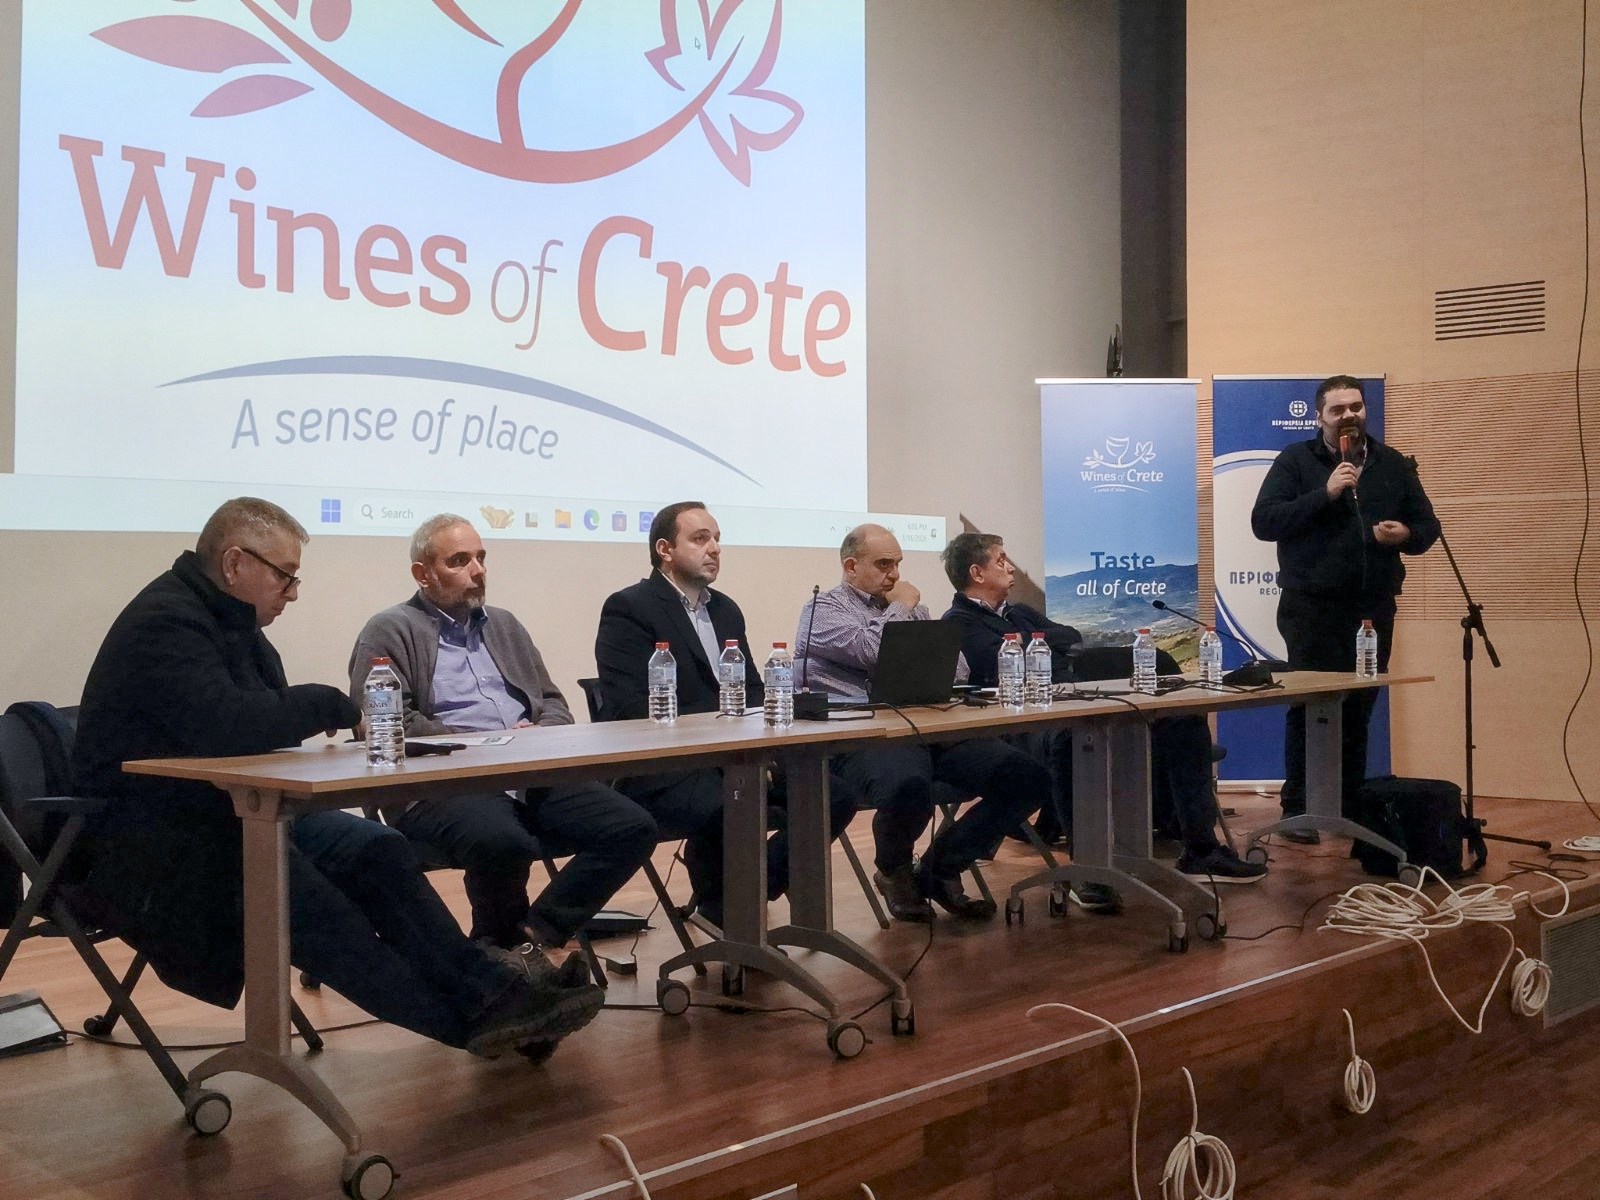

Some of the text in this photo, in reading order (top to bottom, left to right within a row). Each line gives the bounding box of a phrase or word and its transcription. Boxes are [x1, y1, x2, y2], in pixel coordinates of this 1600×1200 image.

[58, 133, 851, 378] Wines of Crete
[231, 398, 559, 460] A sense of place
[1080, 468, 1164, 483] Wines of Crete
[381, 507, 414, 519] Search
[1090, 551, 1155, 571] Taste
[1076, 578, 1167, 599] all of Crete
[1259, 587, 1281, 596] REGI
